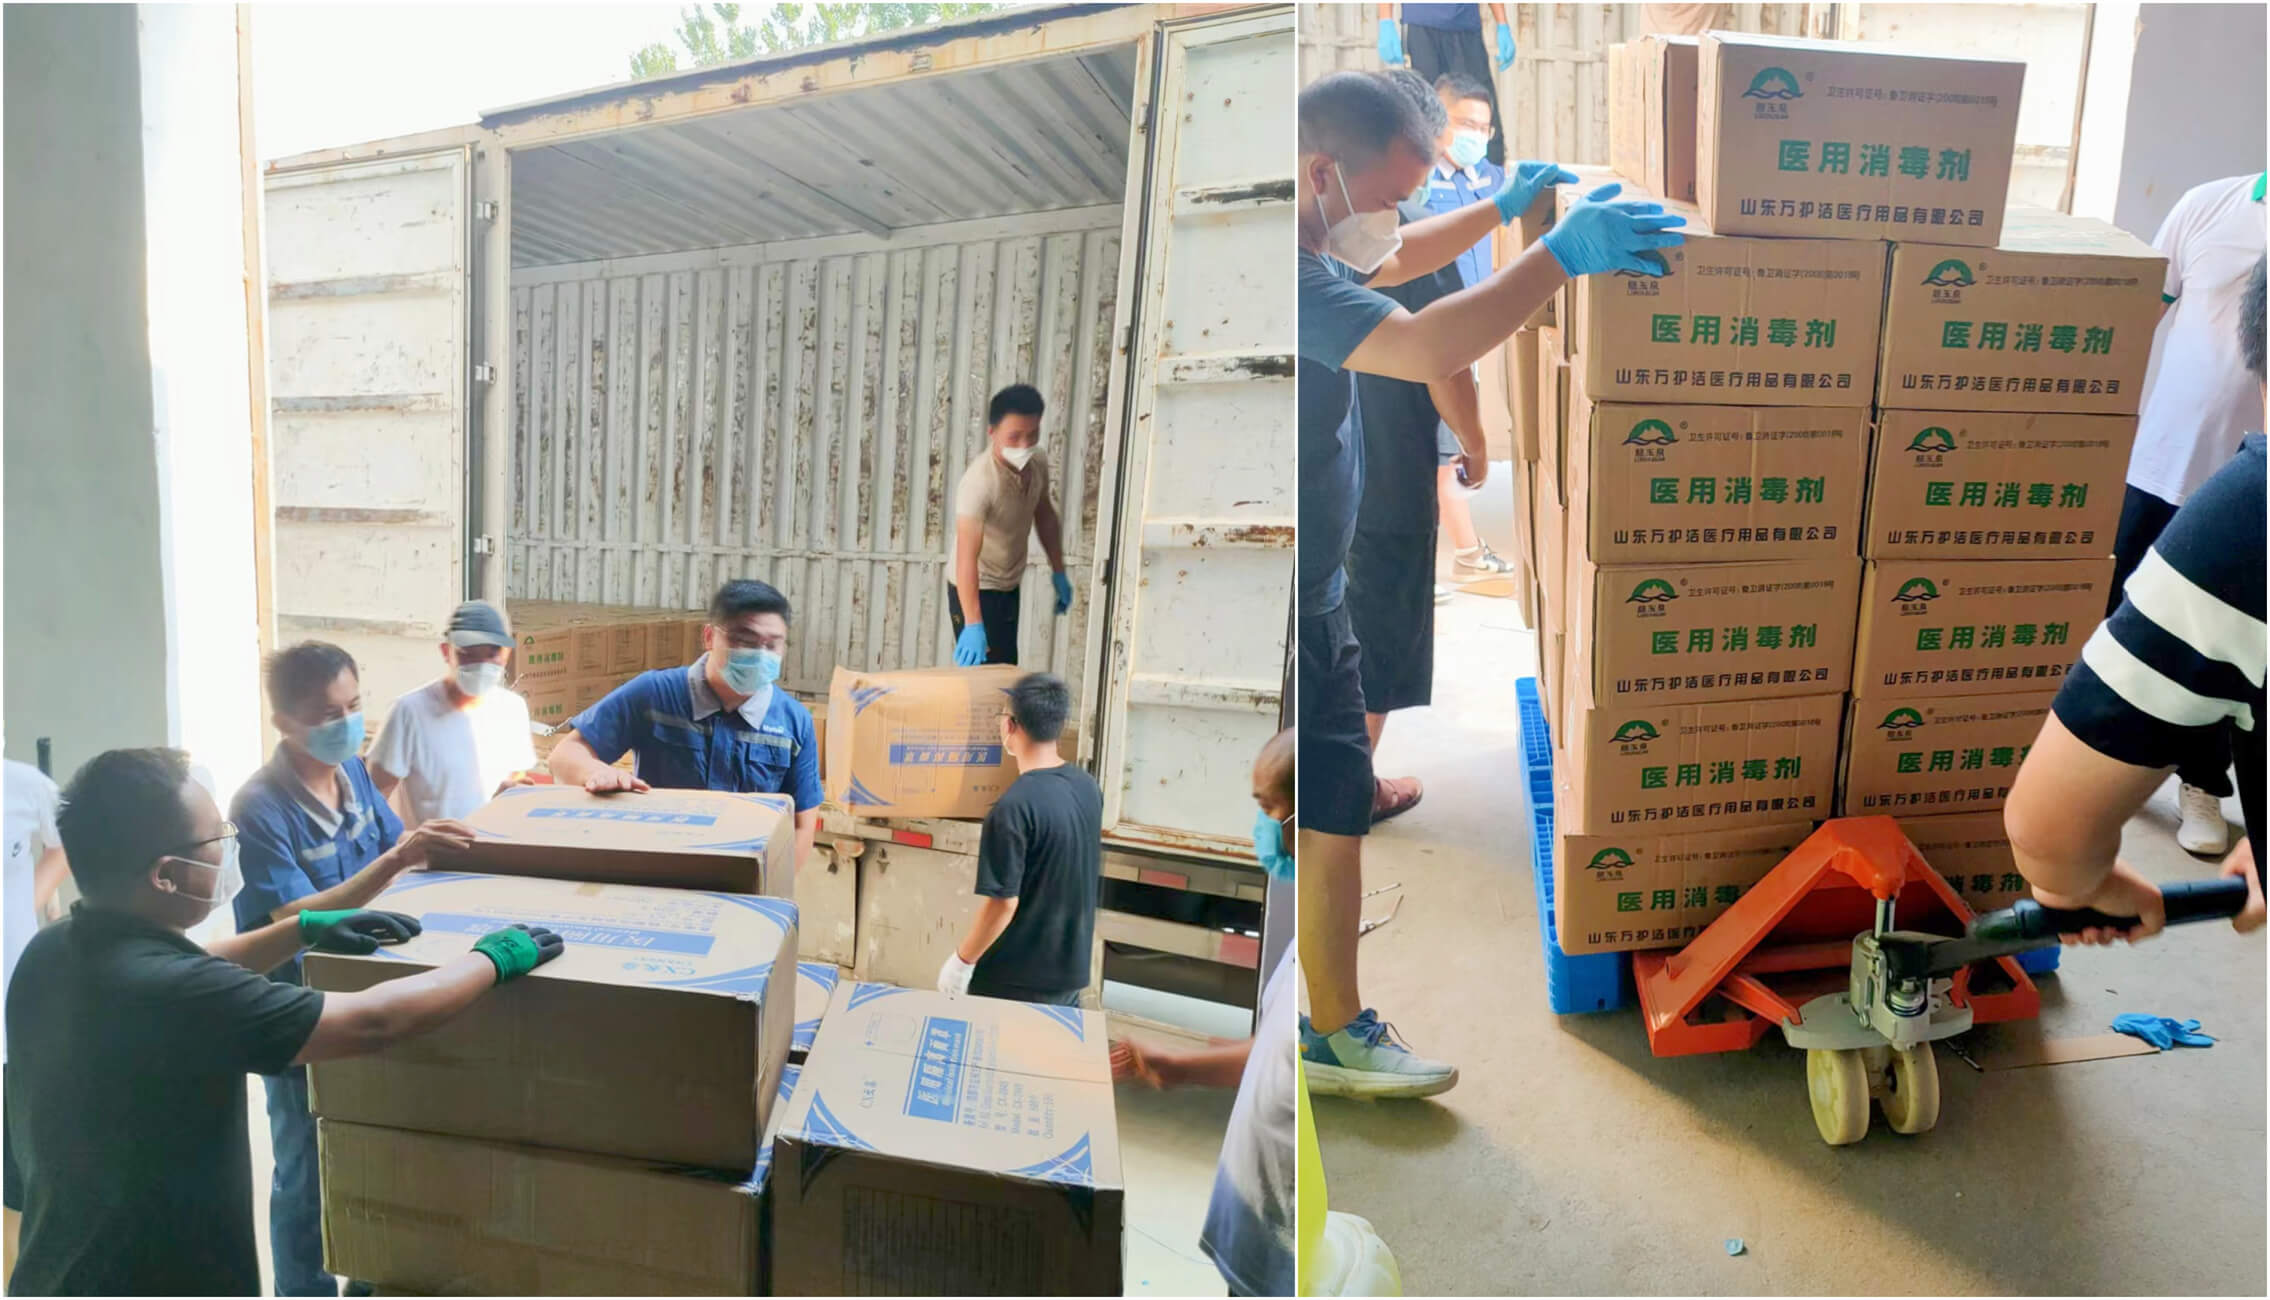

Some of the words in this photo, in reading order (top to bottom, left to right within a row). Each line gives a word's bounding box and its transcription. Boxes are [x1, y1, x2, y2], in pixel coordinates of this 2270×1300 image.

[1778, 139, 1972, 182] 医用消毒剂
[1740, 198, 1985, 227] 山东万护洁医疗用品有限公司
[1651, 313, 1837, 348] 医用消毒剂
[1941, 320, 2115, 355] 医用消毒剂
[1616, 368, 1852, 389] 山东万护洁医疗用品有限公司
[1902, 373, 2121, 395] 山东万护洁医疗用品有限公司
[1650, 476, 1825, 504] 医用消毒剂
[1925, 481, 2089, 508] 医用消毒剂
[1614, 526, 1838, 545] 山东万护洁医疗用品有限公司
[1651, 623, 1818, 655] 医用消毒剂
[1916, 621, 2070, 651] 医用消毒剂
[1617, 668, 1829, 693] 山东万护洁医疗用品有限公司
[1641, 756, 1802, 790] 医用消毒剂
[1897, 744, 2032, 773] 医用消毒
[1617, 882, 1757, 913] 医用消毒
[1588, 925, 1707, 945] 山东万护洁医疗
